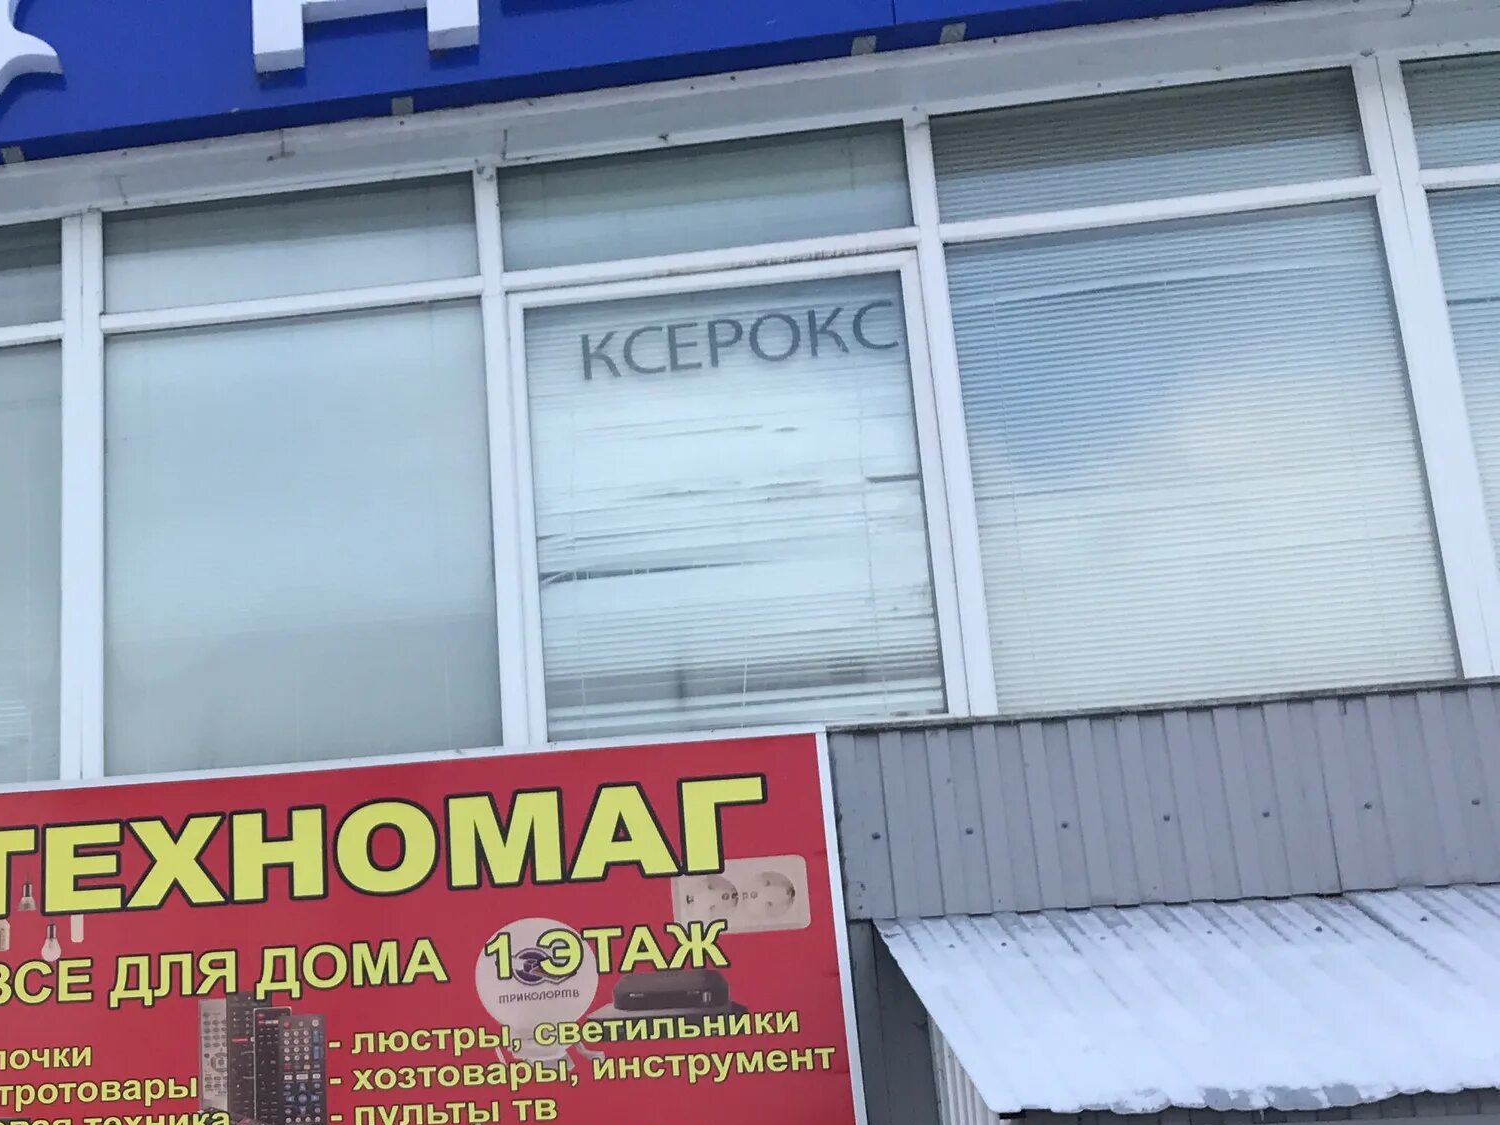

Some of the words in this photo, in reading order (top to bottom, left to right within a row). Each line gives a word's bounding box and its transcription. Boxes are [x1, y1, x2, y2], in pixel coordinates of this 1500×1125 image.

[580, 300, 899, 380] КСЕРОКС
[108, 947, 240, 1011] ДЛЯ
[253, 936, 447, 1000] ДОМА
[486, 931, 512, 982] 1
[539, 920, 729, 977] ЭТАЖ
[353, 1023, 522, 1057] люстры,
[534, 1012, 800, 1047] светильники
[353, 1057, 580, 1090] хозтовары,
[593, 1047, 835, 1082] инструмент
[516, 1095, 557, 1121] тв
